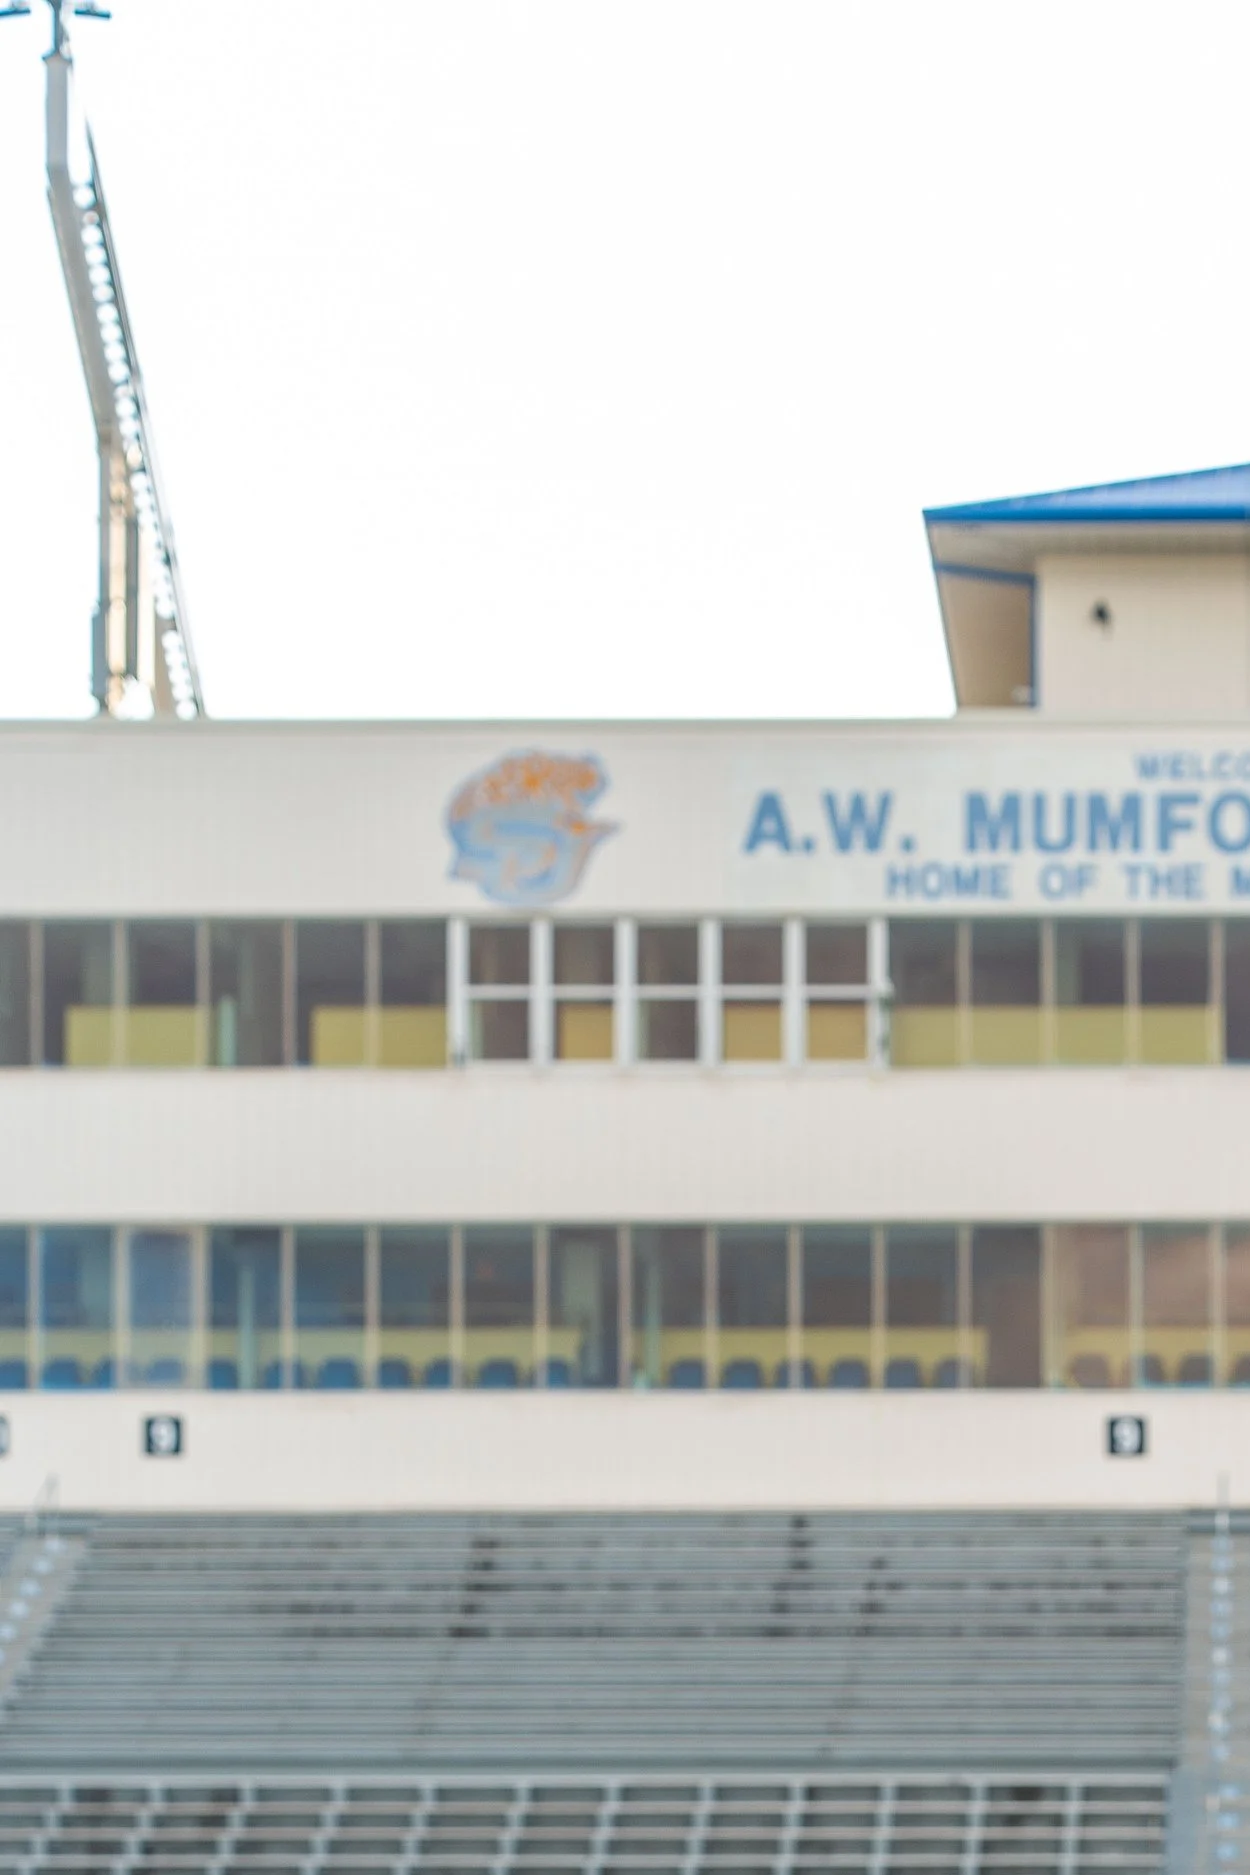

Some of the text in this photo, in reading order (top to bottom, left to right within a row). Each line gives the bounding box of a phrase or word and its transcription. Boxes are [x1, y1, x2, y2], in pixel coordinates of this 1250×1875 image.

[742, 790, 917, 855] A.W.
[885, 863, 1011, 900] HOME
[1039, 863, 1096, 900] OF
[1123, 863, 1205, 900] THE
